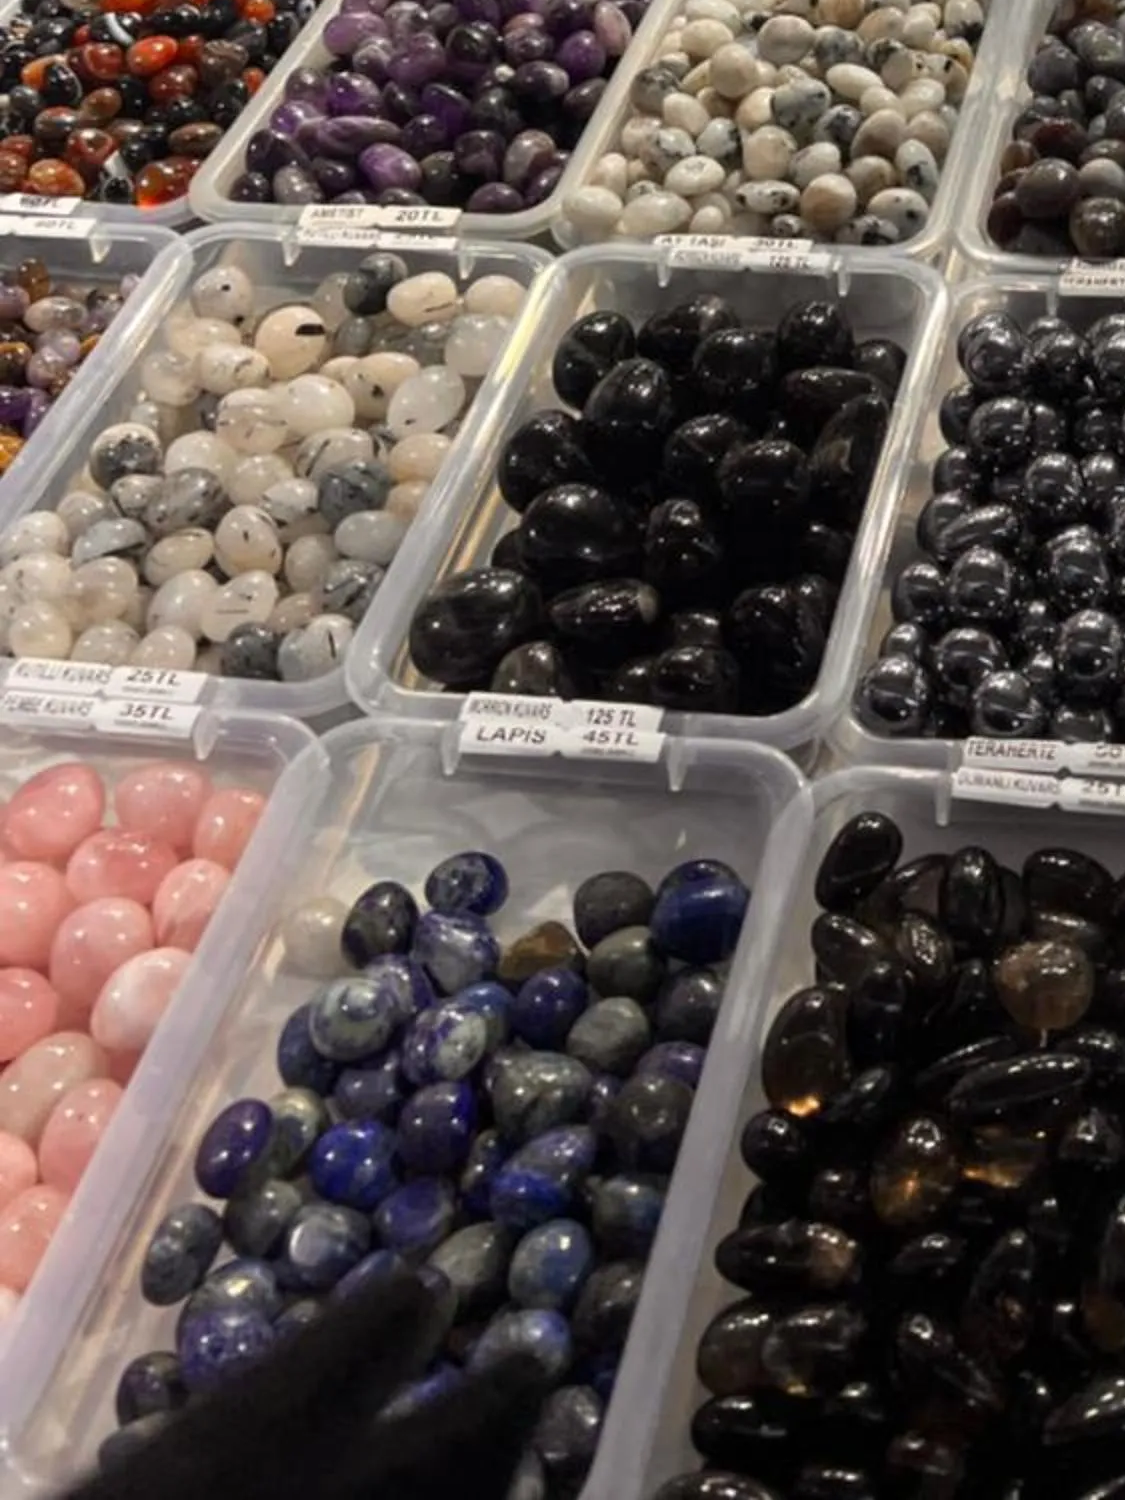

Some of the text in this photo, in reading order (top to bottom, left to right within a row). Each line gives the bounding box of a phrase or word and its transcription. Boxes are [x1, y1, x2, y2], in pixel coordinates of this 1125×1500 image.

[395, 209, 444, 221] 20TL
[126, 668, 181, 686] 25TL
[119, 702, 175, 721] 35TL
[586, 707, 616, 726] 125
[619, 709, 638, 728] TL
[476, 724, 640, 747] LAPİS 45TL
